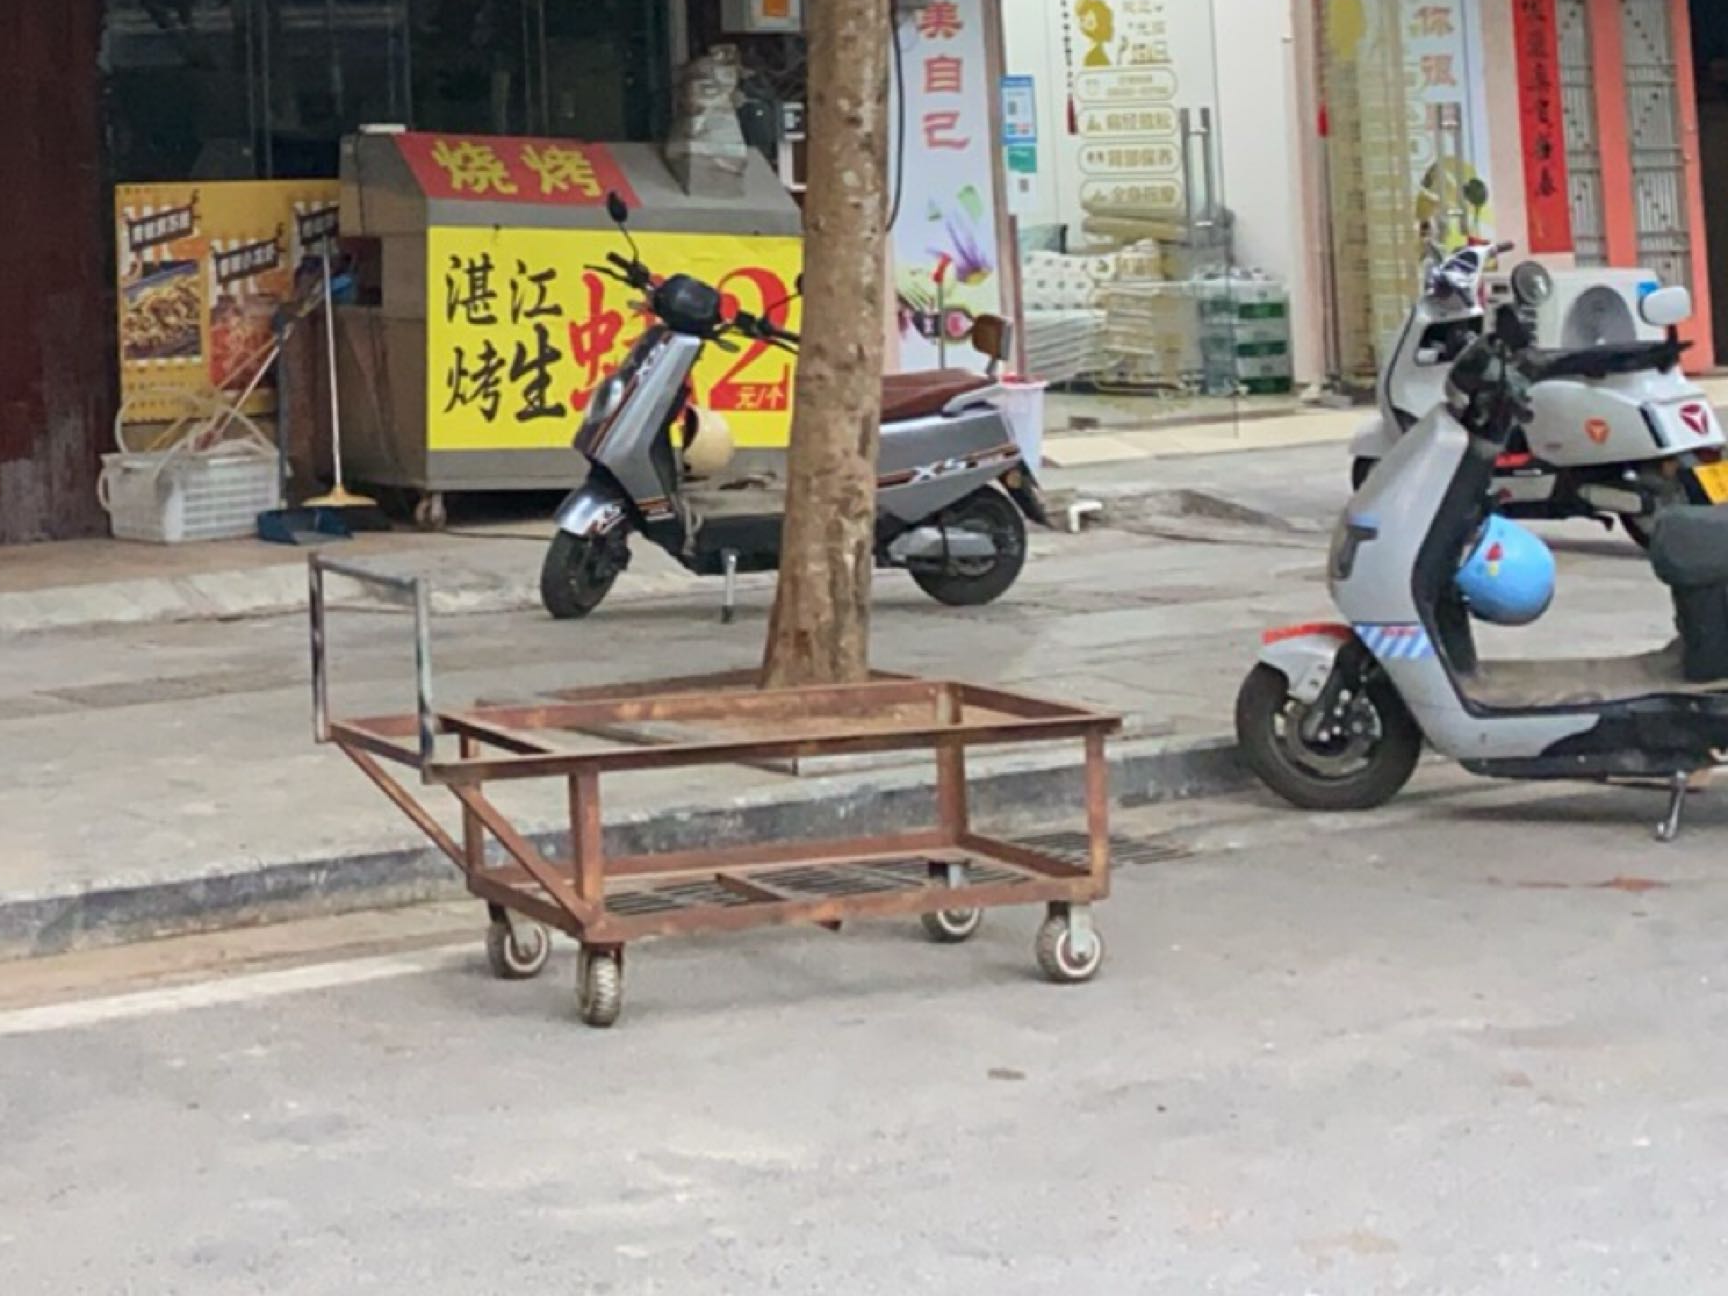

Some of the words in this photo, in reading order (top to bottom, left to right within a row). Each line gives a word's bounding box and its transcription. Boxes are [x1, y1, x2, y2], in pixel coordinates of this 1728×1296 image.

[432, 139, 604, 198] 烧烤
[445, 252, 564, 326] 湛江
[444, 322, 568, 424] 烤生
[709, 266, 791, 411] 2
[735, 385, 786, 410] 元/个
